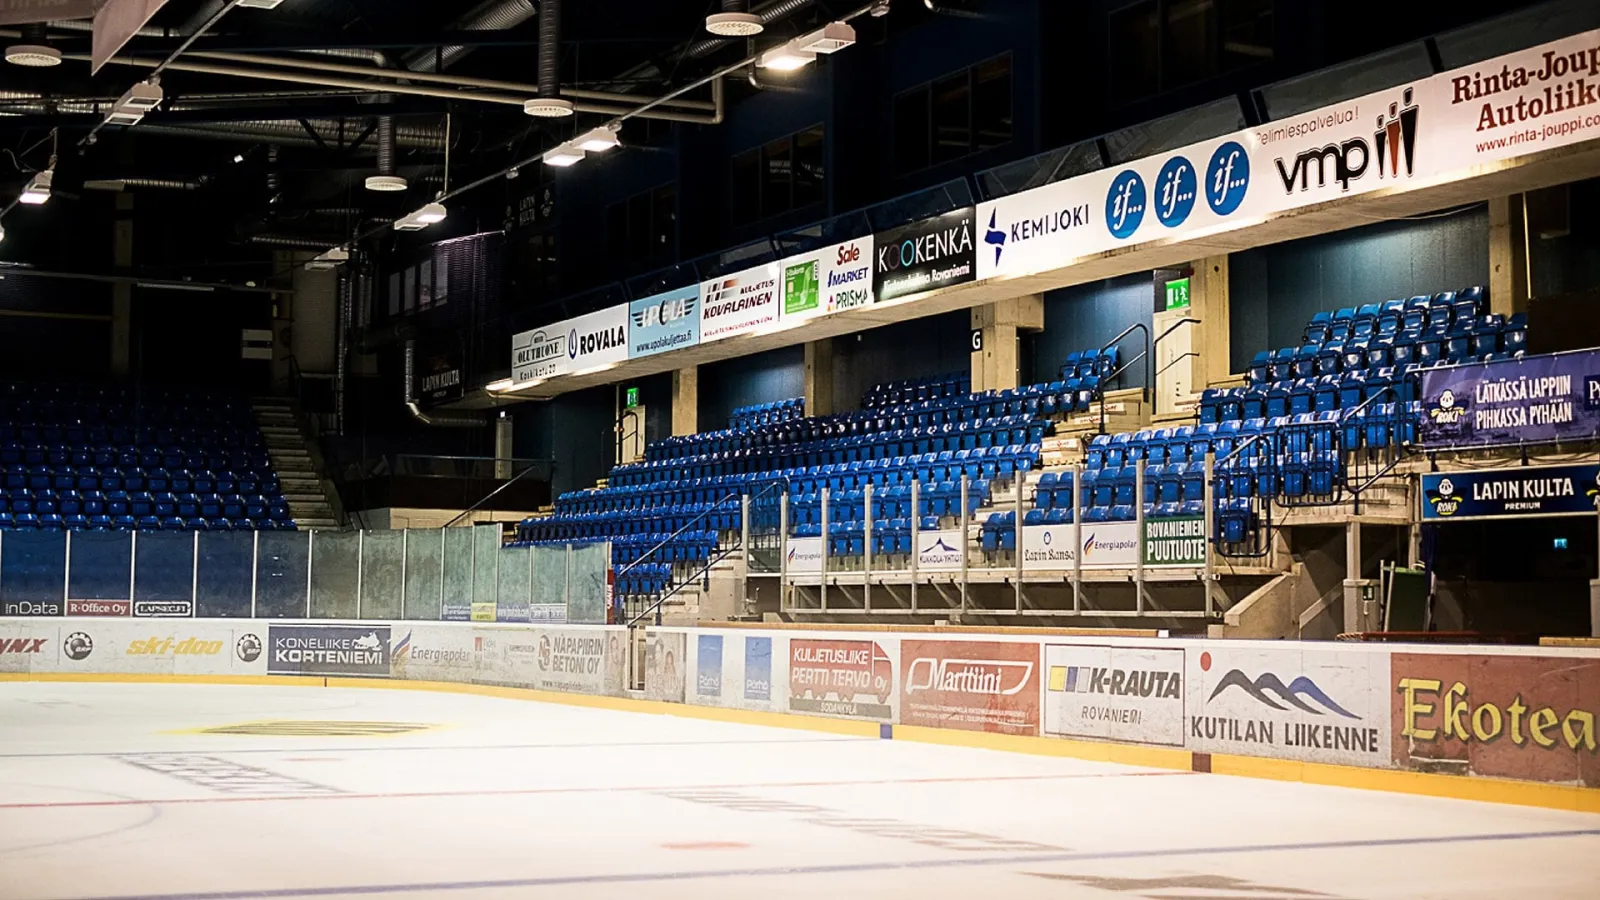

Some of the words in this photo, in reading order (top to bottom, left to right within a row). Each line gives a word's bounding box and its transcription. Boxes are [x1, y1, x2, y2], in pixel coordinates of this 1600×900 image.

[1476, 79, 1600, 132] Autoliik
[1274, 136, 1369, 195] vmp
[1011, 204, 1089, 243] KEMIJOKI
[836, 242, 860, 266] Sale
[879, 218, 973, 273] KOOKENKÄ
[932, 261, 970, 282] Rovaniemi
[703, 291, 773, 320] KOVALAINEN
[836, 287, 868, 309] PRISMA
[580, 325, 625, 356] ROVALA
[972, 331, 981, 350] G
[1476, 376, 1527, 403] LÄTKÄSSÄ
[1529, 374, 1571, 398] LAPPIIN
[1476, 407, 1527, 430] PIHKASSA
[1530, 399, 1573, 425] PYHÄÄN
[1473, 481, 1519, 500] LAPIN
[1524, 478, 1574, 498] KULTA
[1505, 502, 1541, 510] PREMIUM
[1146, 520, 1205, 538] ROVANIEMEN
[1025, 549, 1047, 562] Lapin
[1094, 540, 1137, 551] Energiapolar
[1146, 539, 1206, 561] PUUTUOTE
[112, 604, 127, 614] Oy
[275, 638, 350, 650] KONELIIKE
[411, 646, 470, 663] Energiapolar
[275, 649, 382, 665] KORTENIEMI
[553, 655, 585, 674] BETONI
[587, 657, 600, 675] OY
[793, 647, 869, 666] KULJETUSLIIKE
[792, 667, 830, 684] PERTTI
[832, 669, 870, 688] TERVO
[926, 658, 1003, 695] Marttiini
[1090, 667, 1181, 699] K-RAUTA
[1081, 705, 1142, 725] ROVANIEMI
[1398, 678, 1597, 750] Ekotea
[1191, 716, 1273, 744] KUTILAN
[1284, 722, 1379, 752] LIIKENNE
